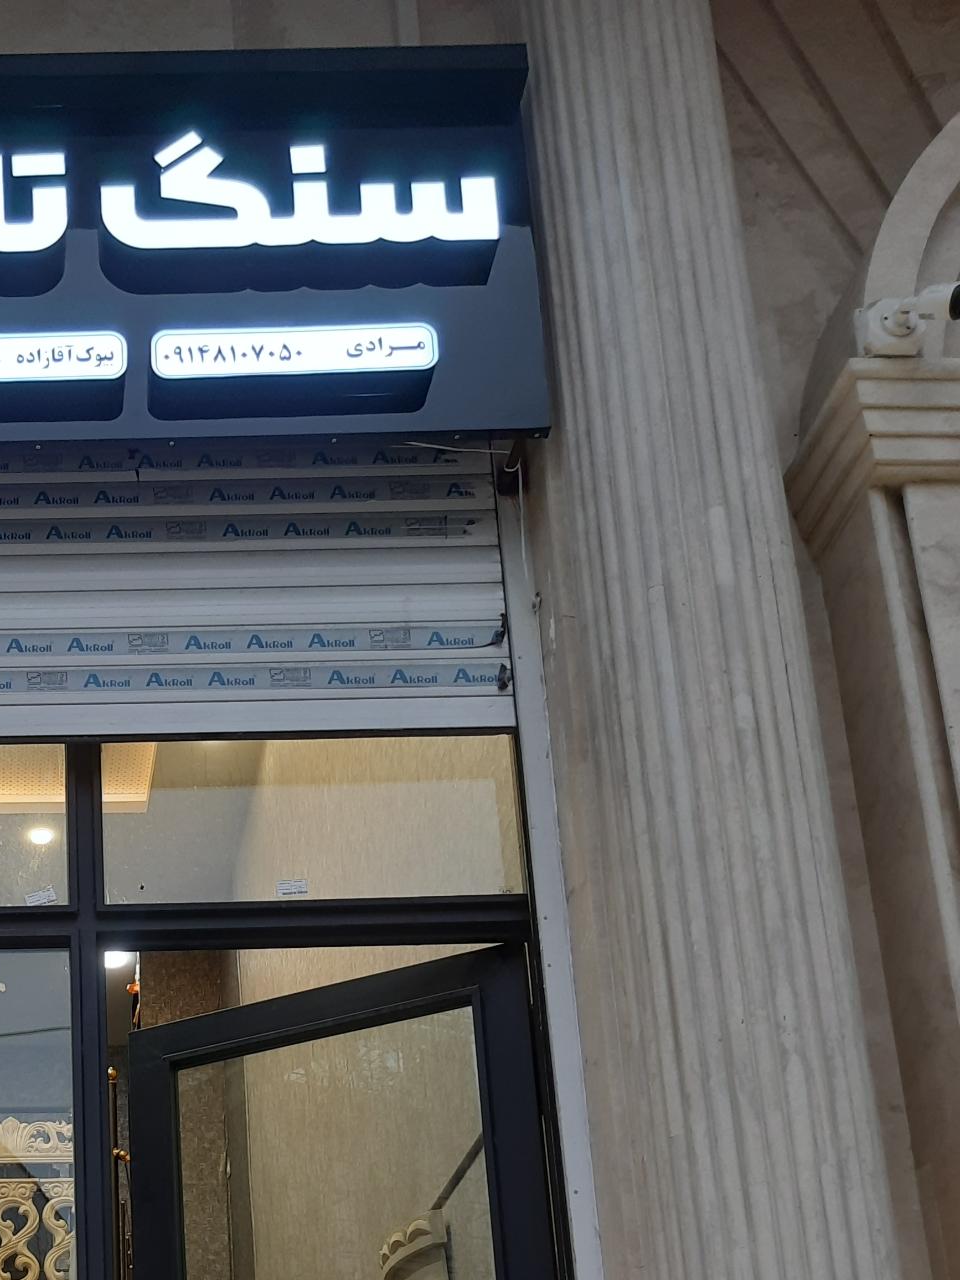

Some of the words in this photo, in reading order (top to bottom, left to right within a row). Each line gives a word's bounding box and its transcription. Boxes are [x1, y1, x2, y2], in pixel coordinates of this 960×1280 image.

[99, 129, 500, 250] سنگ
[164, 343, 303, 364] ۰۹۱۴۸۱۰۷۰۵۰
[6, 638, 52, 652] AkRoll
[67, 638, 113, 652] AkRoll
[185, 635, 231, 650] AkRoll
[247, 634, 293, 648] AkRoll
[308, 633, 355, 647] AkRoll
[427, 632, 474, 646] AkRoll
[84, 673, 130, 687] AkRoll
[146, 672, 192, 687] AkRoll
[208, 671, 255, 686] AkRoll
[328, 670, 374, 684] AkRoll
[390, 669, 437, 684] AkRoll
[453, 668, 498, 683] AkRol
